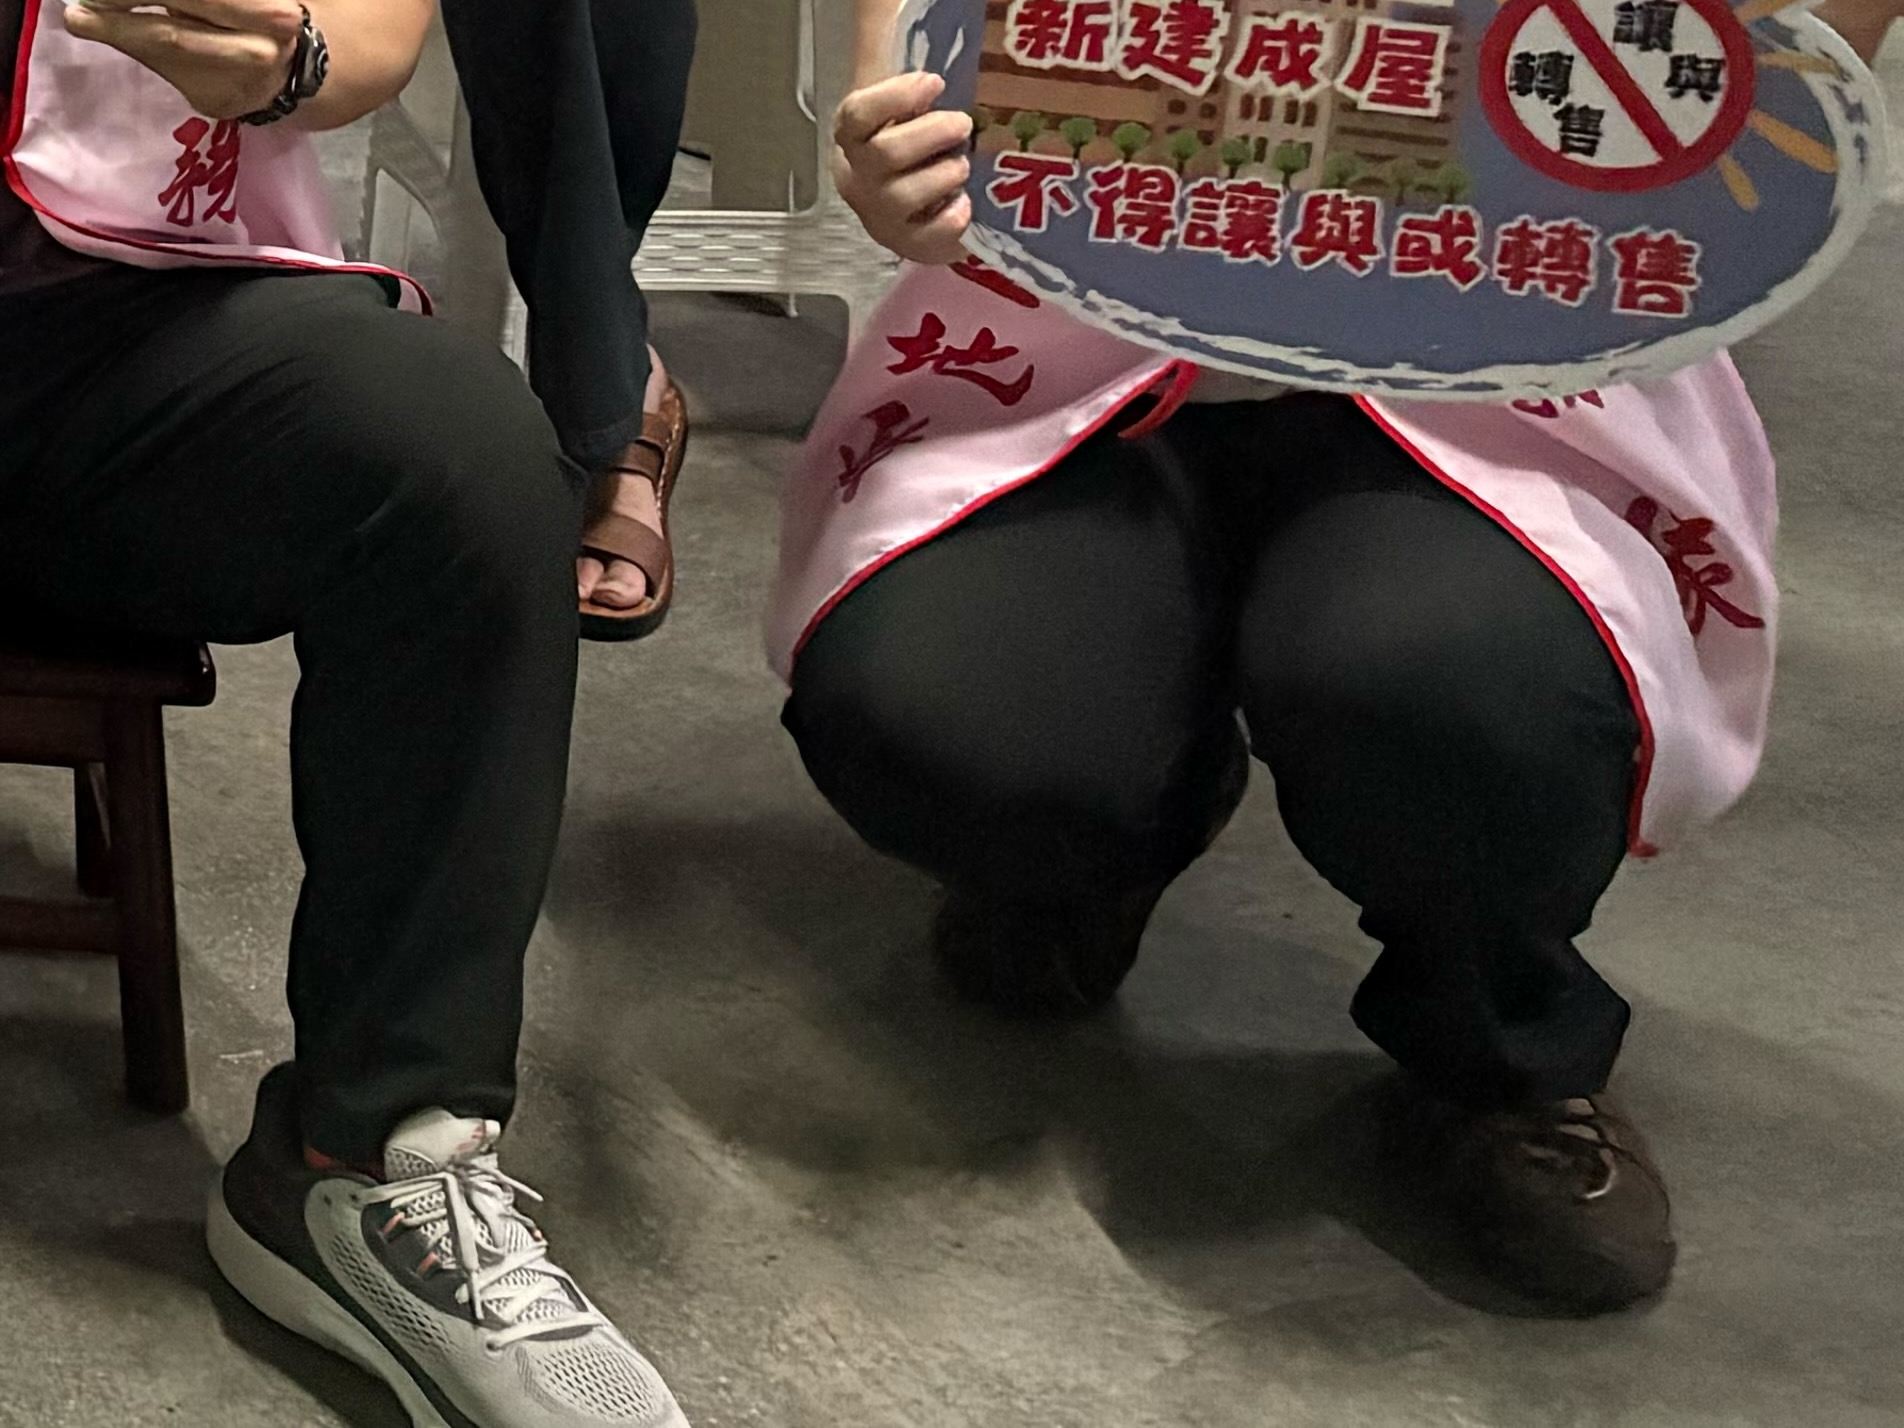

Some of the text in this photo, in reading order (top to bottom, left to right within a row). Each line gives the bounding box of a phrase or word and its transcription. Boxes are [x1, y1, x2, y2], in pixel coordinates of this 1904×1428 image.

[992, 152, 1703, 318] 不得讓與或轉售
